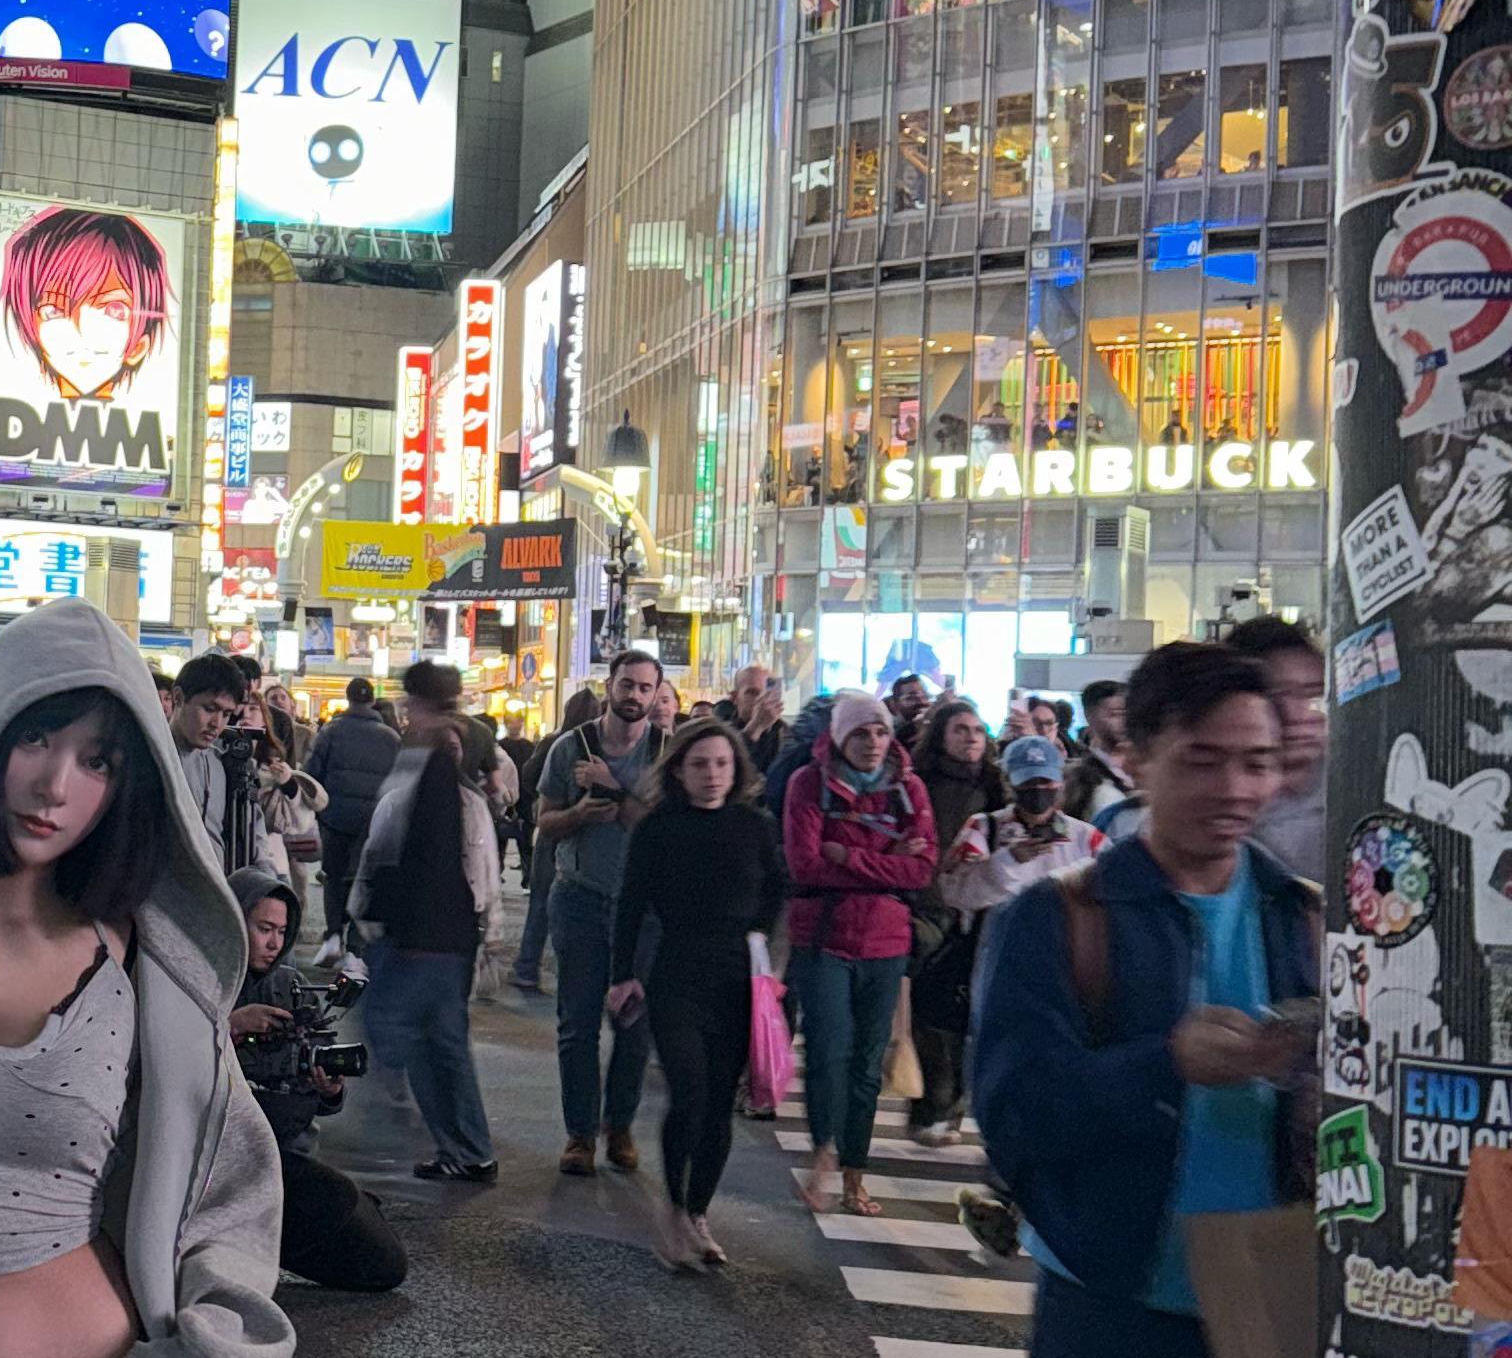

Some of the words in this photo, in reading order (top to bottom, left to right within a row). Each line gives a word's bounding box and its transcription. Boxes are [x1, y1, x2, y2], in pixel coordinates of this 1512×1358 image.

[28, 65, 68, 80] Vision
[242, 35, 452, 105] ACN
[464, 300, 492, 432] カラオケ
[881, 439, 1316, 502] STARBUCK
[500, 535, 563, 568] ALVARK
[1349, 506, 1400, 554] MORE
[1355, 544, 1393, 580] THAN
[1394, 534, 1409, 555] A
[1360, 556, 1416, 602] CYCLIST
[1406, 1070, 1480, 1122] END
